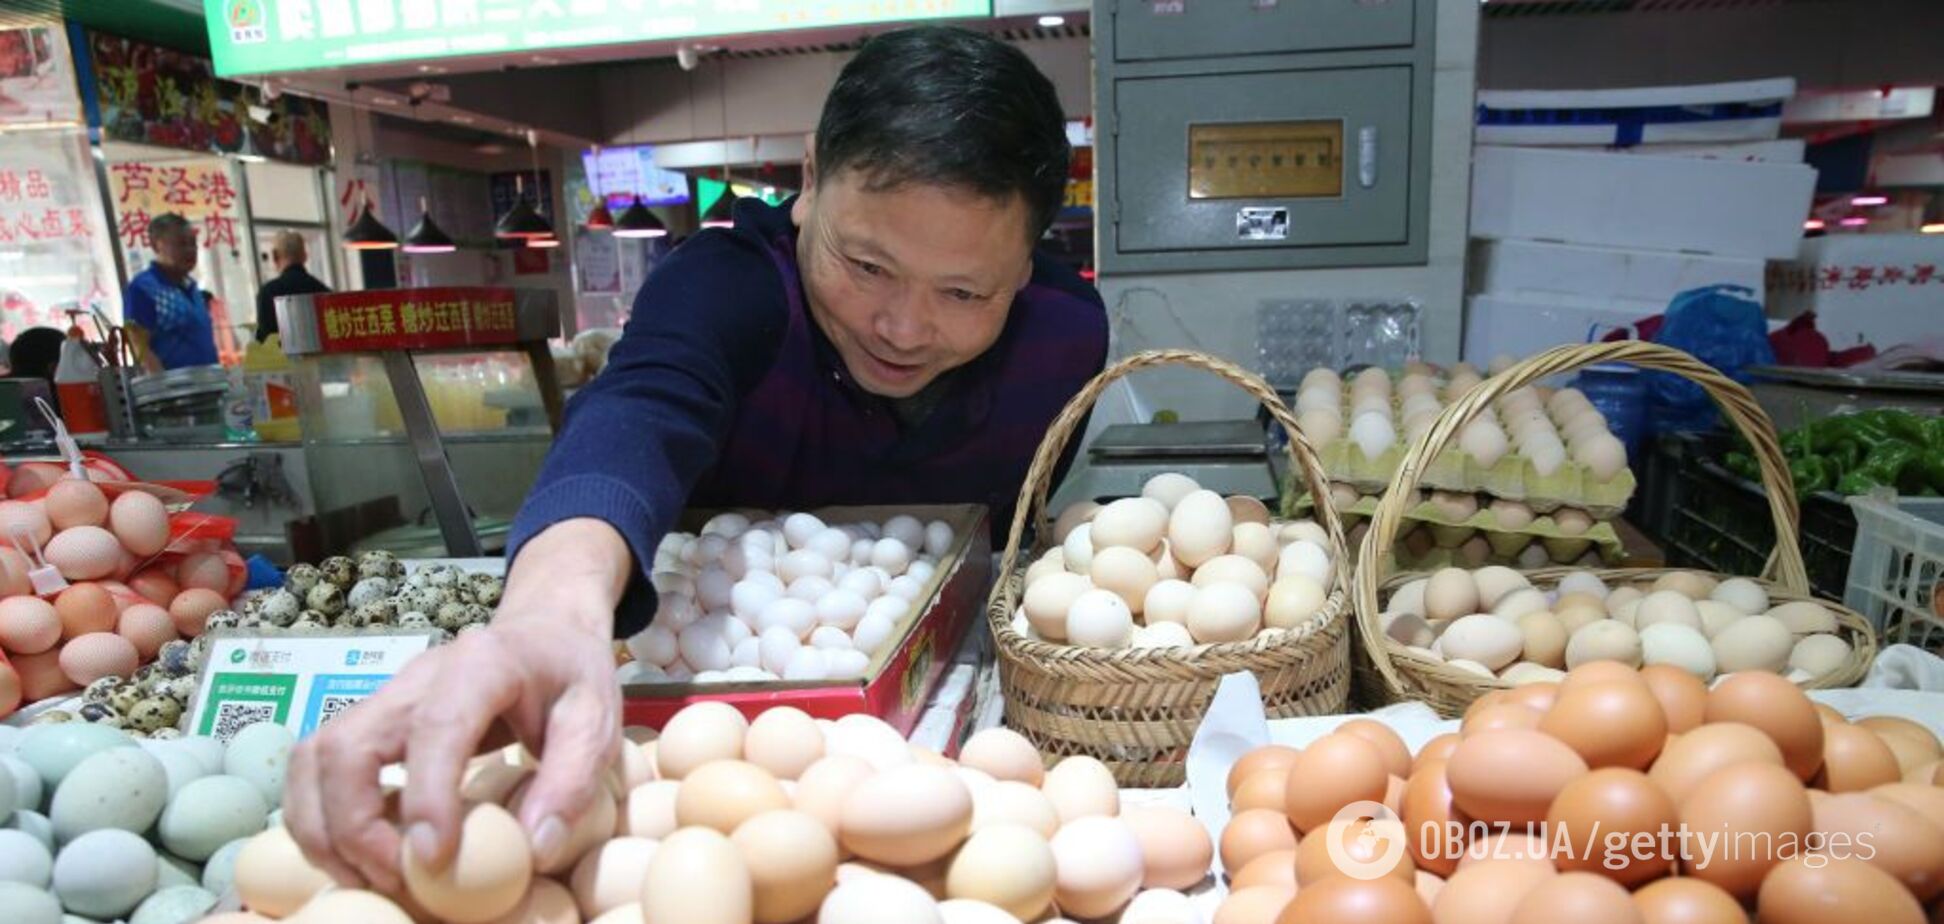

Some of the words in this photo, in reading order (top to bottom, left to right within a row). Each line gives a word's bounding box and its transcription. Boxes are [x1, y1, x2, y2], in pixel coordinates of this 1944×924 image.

[110, 161, 237, 208] 芦泾港
[116, 203, 239, 248] 猪肉
